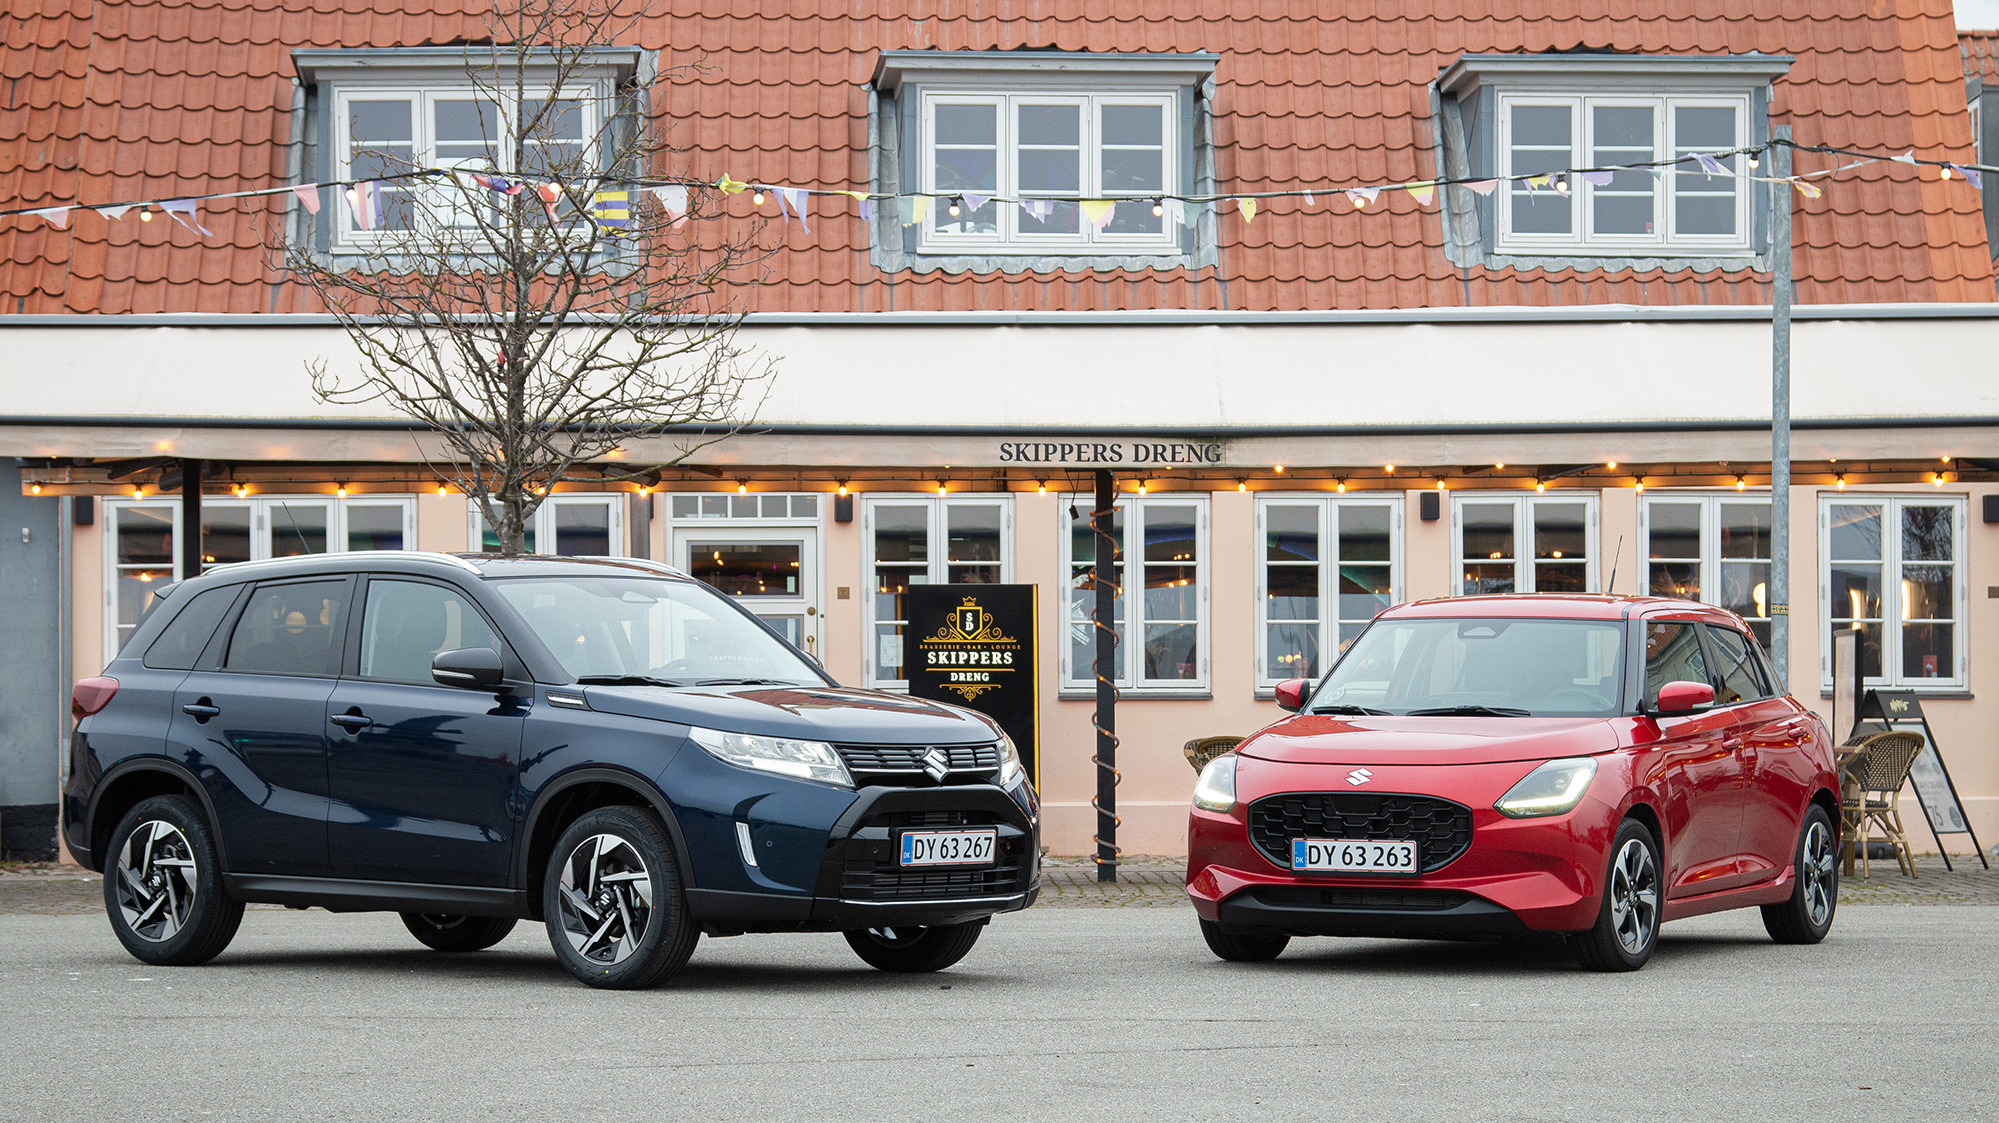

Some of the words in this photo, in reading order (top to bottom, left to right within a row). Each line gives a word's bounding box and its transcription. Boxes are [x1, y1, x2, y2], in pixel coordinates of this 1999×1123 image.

[999, 442, 1123, 463] SKIPPERS
[1132, 443, 1222, 463] DRENG
[927, 651, 1013, 665] SKIPPERS
[950, 672, 990, 682] DRENG
[914, 838, 937, 860] DY
[940, 837, 959, 859] 63
[963, 836, 993, 859] 267
[1308, 845, 1336, 866] DY
[1341, 845, 1367, 866] 63
[1372, 846, 1412, 867] 263
